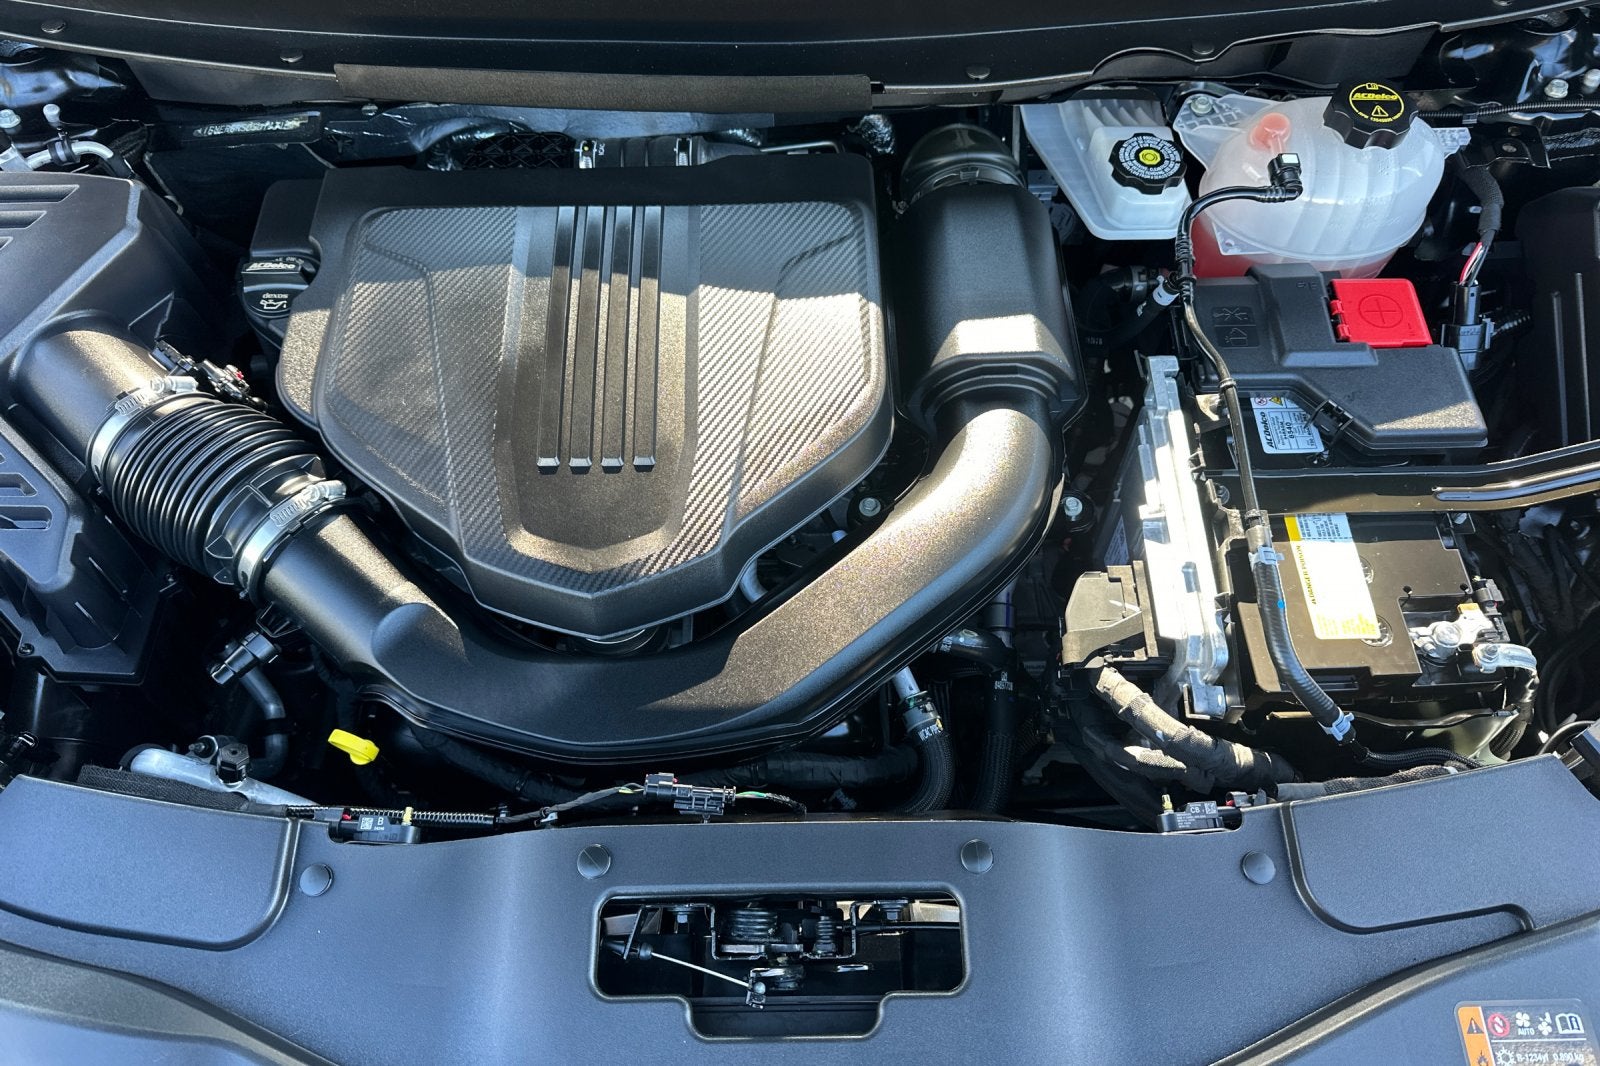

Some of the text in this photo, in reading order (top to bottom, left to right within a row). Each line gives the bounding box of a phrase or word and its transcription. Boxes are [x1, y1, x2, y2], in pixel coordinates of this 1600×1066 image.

[1260, 412, 1275, 448] ACDelco
[377, 816, 384, 825] B
[1517, 1027, 1535, 1036] AUTO
